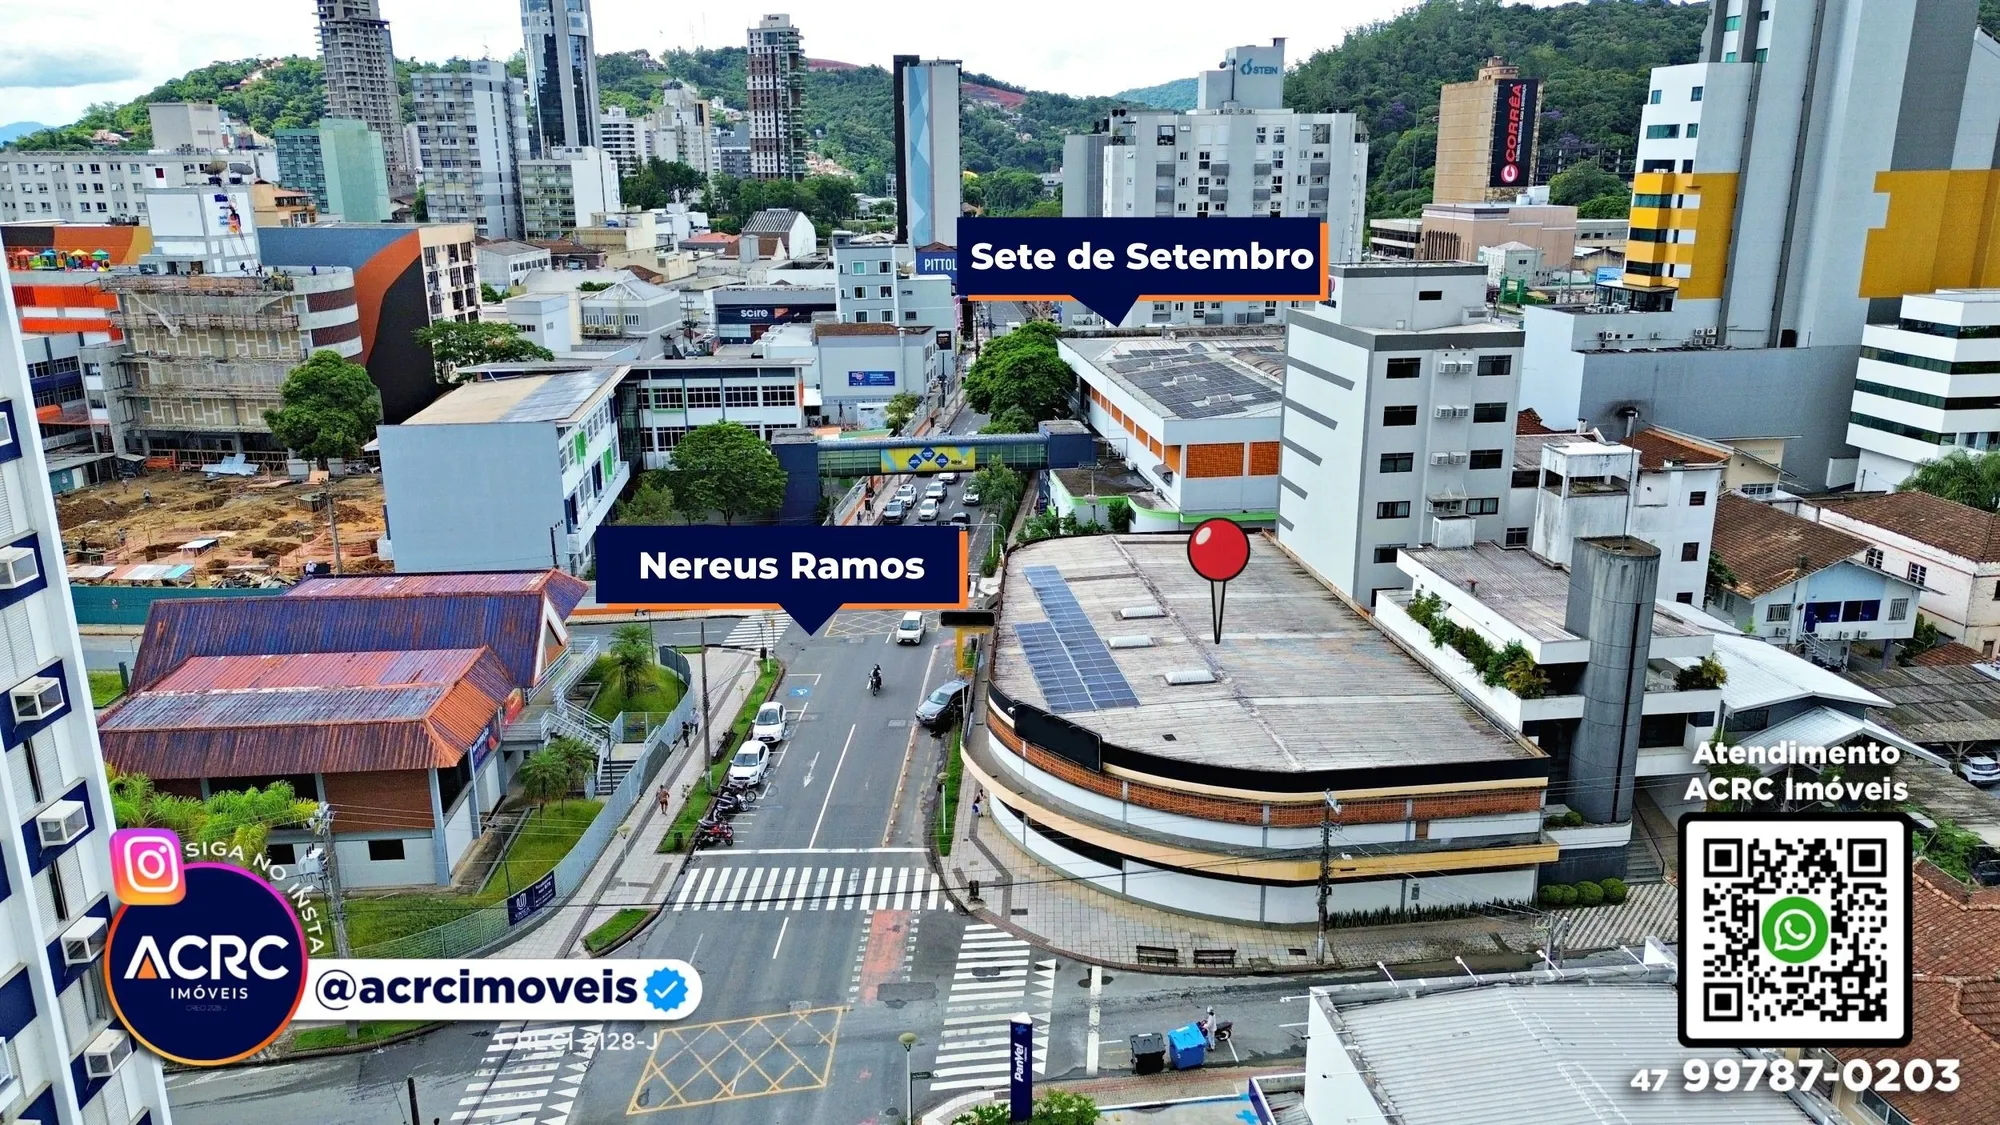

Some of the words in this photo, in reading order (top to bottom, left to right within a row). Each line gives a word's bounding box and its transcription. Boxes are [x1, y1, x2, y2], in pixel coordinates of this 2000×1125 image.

[1253, 66, 1278, 75] STEIN
[1505, 84, 1522, 162] CORRÊA
[924, 258, 957, 271] PITTOL
[740, 307, 769, 318] scire
